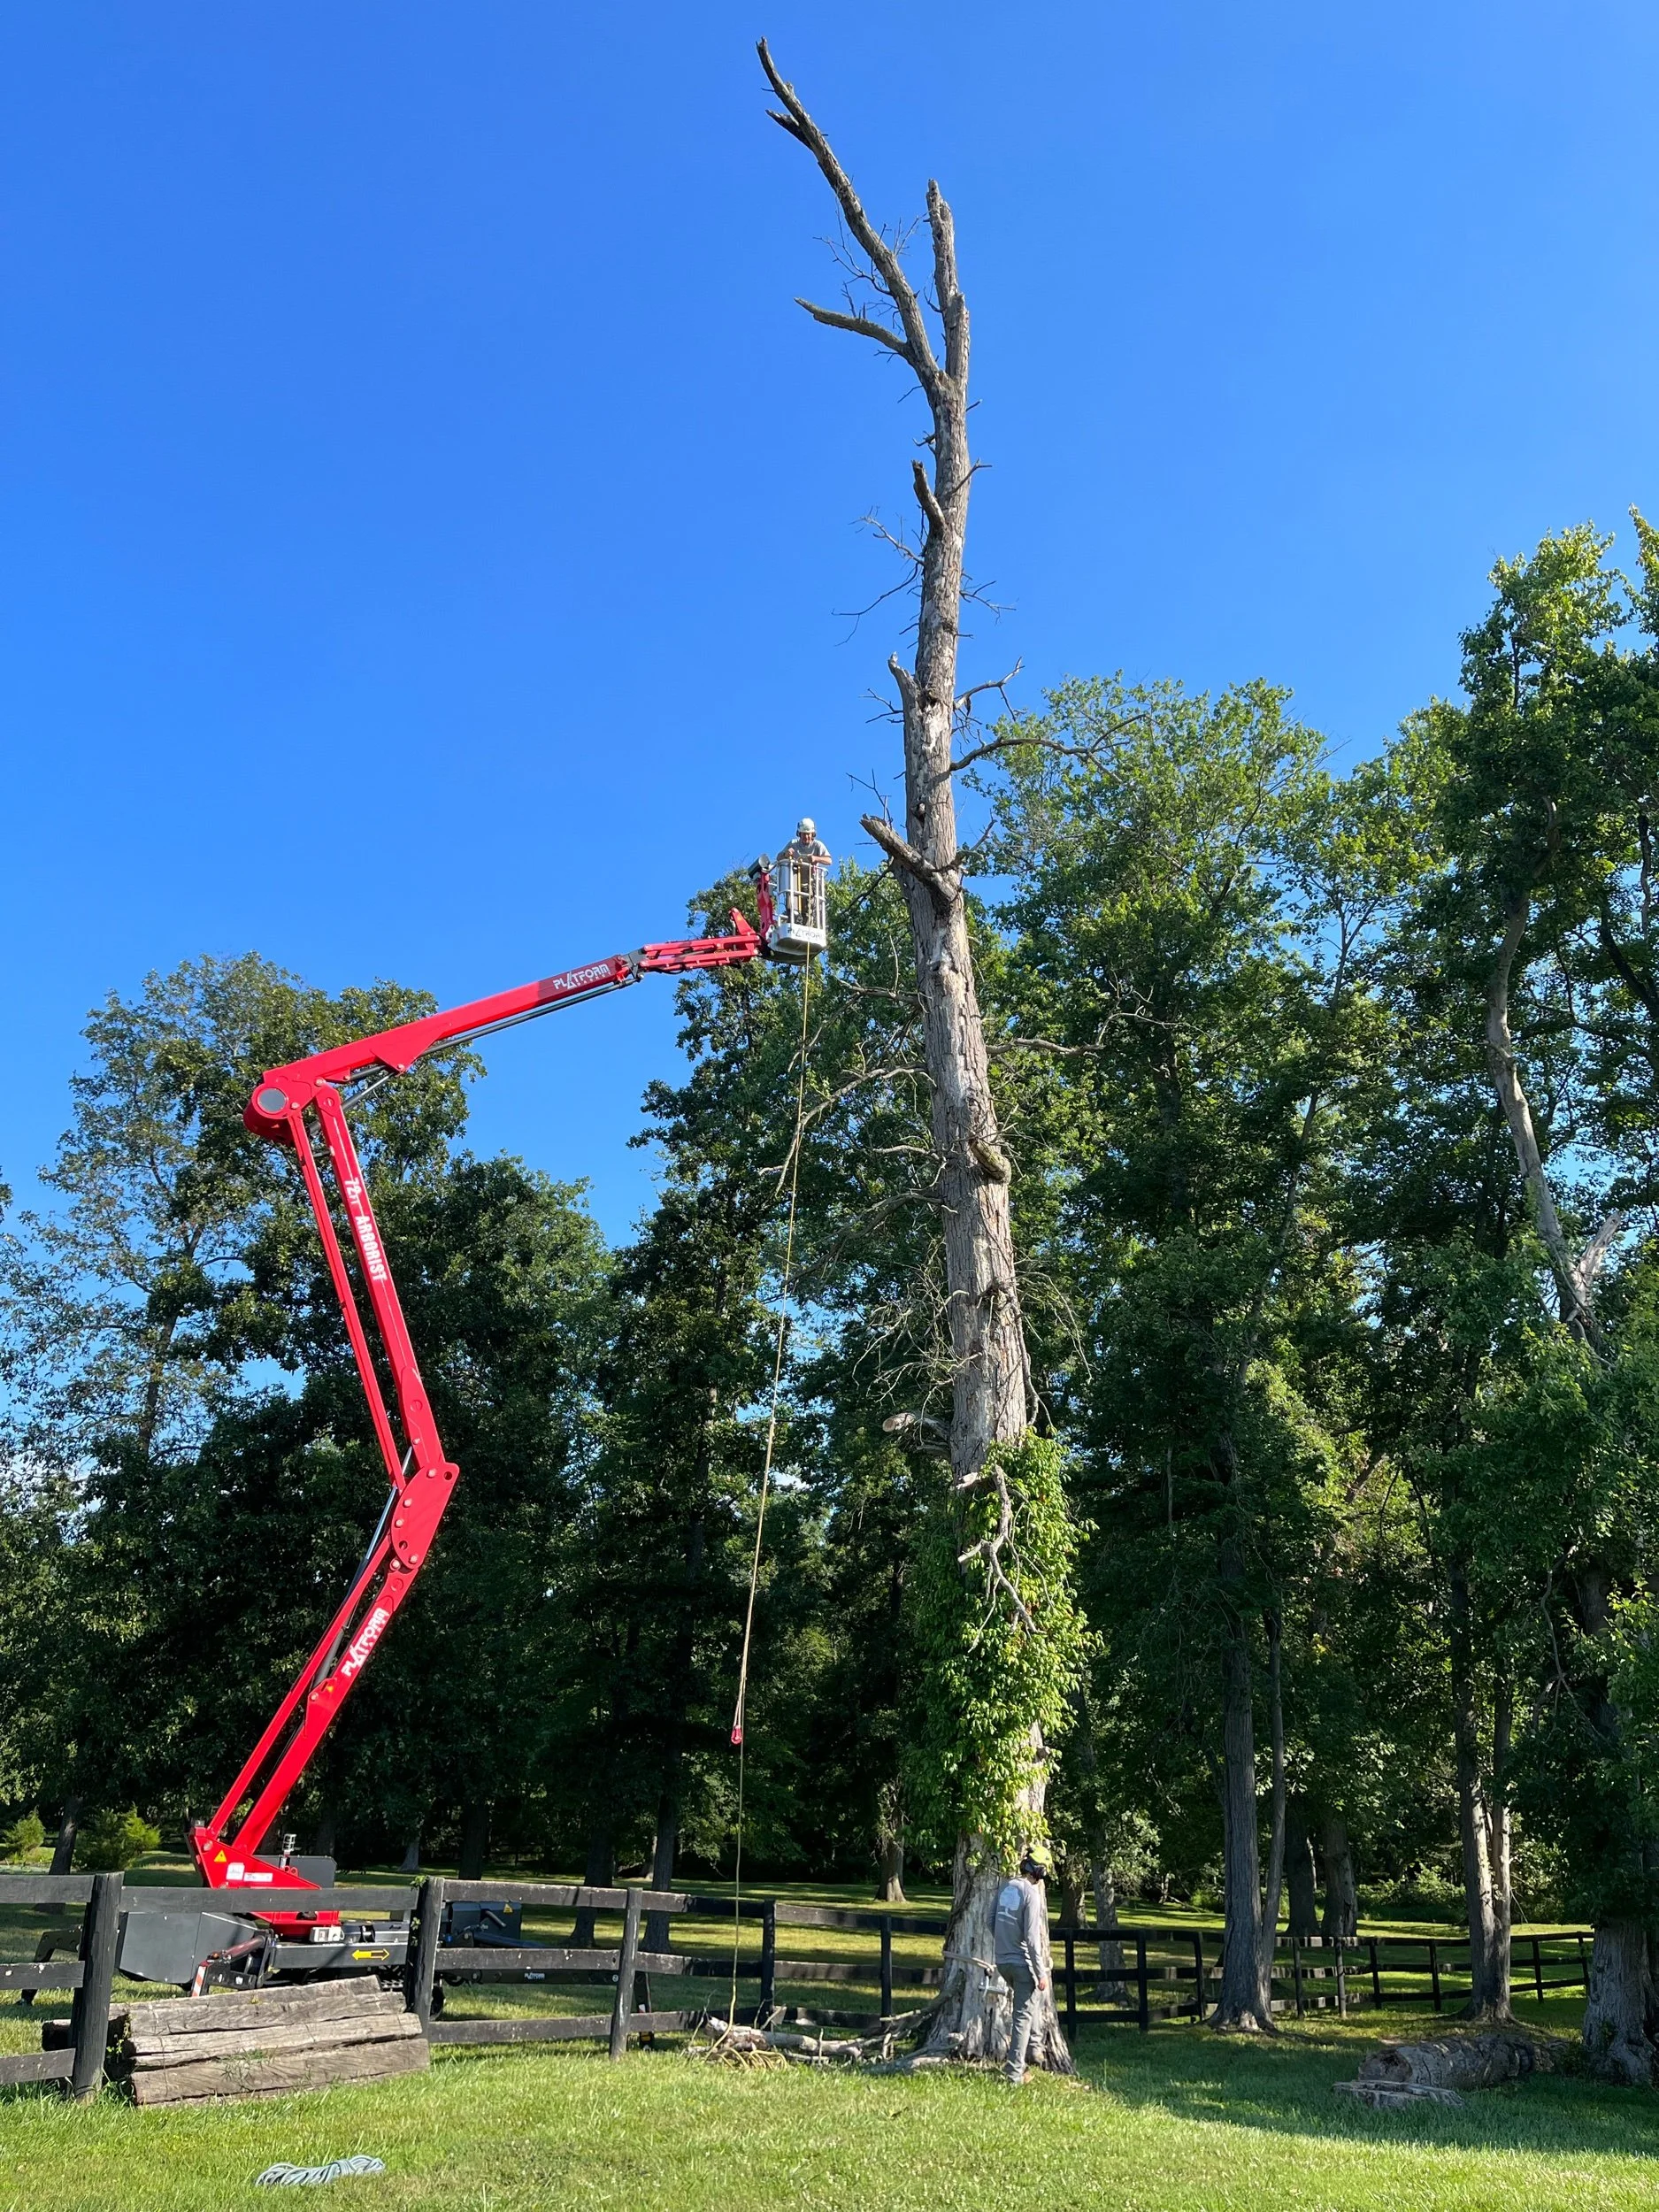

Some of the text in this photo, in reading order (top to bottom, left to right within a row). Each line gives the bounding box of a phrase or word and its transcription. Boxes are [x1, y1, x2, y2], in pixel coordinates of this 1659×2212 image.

[552, 964, 611, 989] PLATFORM
[355, 1216, 388, 1280] ARBORIST
[341, 1608, 388, 1677] PLATFORM
